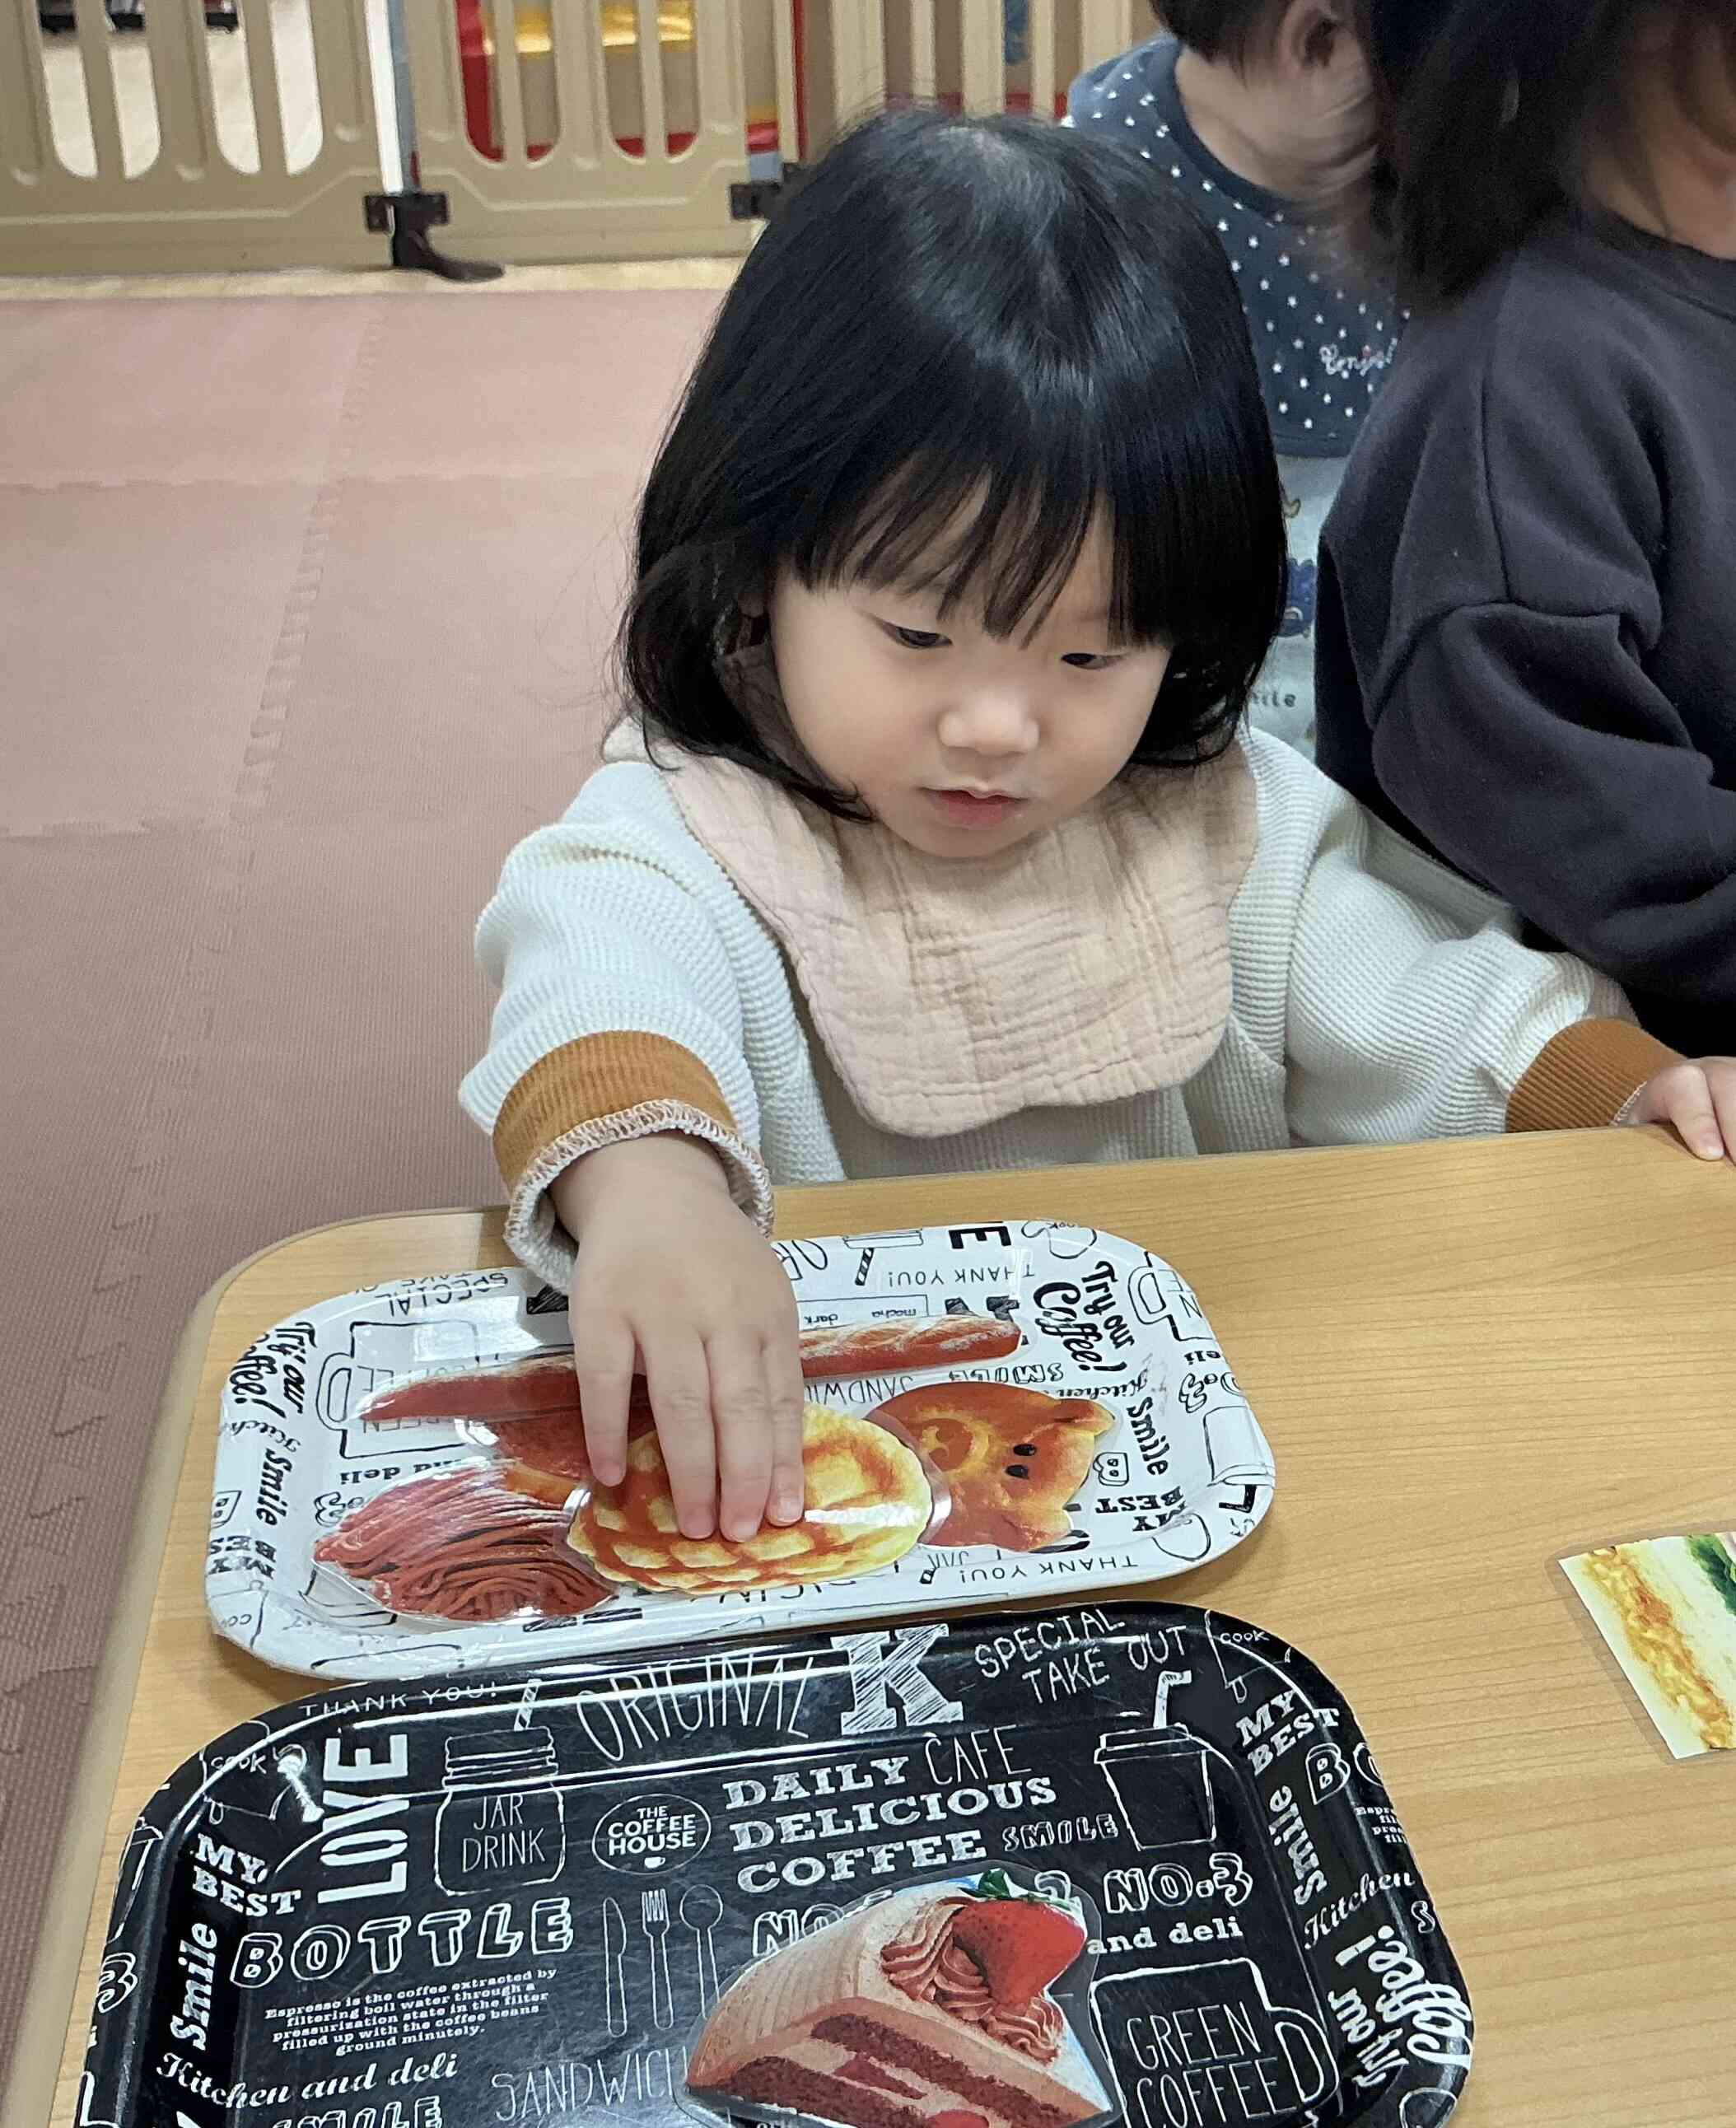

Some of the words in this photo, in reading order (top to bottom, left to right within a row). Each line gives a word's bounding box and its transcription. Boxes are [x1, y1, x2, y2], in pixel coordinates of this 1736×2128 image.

[889, 1270, 945, 1288] YOU!
[955, 1263, 1035, 1284] THANK
[1033, 1281, 1127, 1372] Coffee!
[1081, 1261, 1118, 1315] Try
[1104, 1314, 1135, 1350] our
[1127, 1396, 1171, 1476] Smile
[258, 1448, 293, 1525] Smile
[340, 1466, 401, 1485] deli
[1095, 1486, 1185, 1514] BEST
[959, 1565, 1028, 1584] YOU!
[1039, 1555, 1139, 1575] THANK
[974, 1609, 1126, 1678] SPECIAL
[1022, 1648, 1110, 1703] TAKE
[1128, 1626, 1186, 1671] OUT
[299, 1693, 407, 1717] THANK
[422, 1681, 497, 1706] YOU!
[576, 1654, 814, 1761] ORIGINAL
[831, 1623, 964, 1735] K
[1236, 1690, 1297, 1747] MY
[924, 1724, 1032, 1785] CAFE
[1248, 1708, 1341, 1776] BEST
[722, 1756, 909, 1809] DAILY
[318, 1734, 409, 1904] LOVE
[474, 1793, 525, 1830] JAR
[608, 1813, 696, 1839] COFFEE
[637, 1805, 668, 1819] THE
[730, 1776, 1057, 1852] DELICIOUS
[1001, 1813, 1119, 1853] SMILE
[194, 1834, 267, 1883] MY
[462, 1827, 546, 1874] DRINK
[609, 1831, 696, 1856] HOUSE
[738, 1830, 987, 1892] COFFEE
[1268, 1785, 1328, 1905] Smile
[191, 1866, 301, 1916] BEST
[1103, 1852, 1253, 1914] NO.3
[1304, 1872, 1415, 1950] Kitchen
[230, 1897, 574, 1989] BOTTLE
[1086, 1927, 1157, 1955] and
[1169, 1916, 1244, 1944] deli
[170, 1923, 217, 2051] Smile
[265, 2001, 342, 2018] Espresso
[346, 1997, 361, 2007] is
[365, 1992, 393, 2004] the
[397, 1985, 447, 2000] coffee
[452, 1970, 533, 1990] extracted
[537, 1968, 558, 1980] by
[287, 2008, 360, 2028] filtering
[364, 2002, 396, 2015] boil
[400, 1995, 450, 2010] water
[455, 1984, 520, 2002] through
[526, 1982, 535, 1991] a
[1328, 1987, 1376, 2044] our
[1335, 1925, 1472, 2070] Coffee!
[273, 2014, 399, 2042] pressurization
[403, 2007, 446, 2021] state
[450, 2004, 468, 2014] in
[472, 1999, 500, 2010] the
[504, 1992, 549, 2006] filter
[282, 2036, 329, 2051] filled
[334, 2032, 354, 2043] up
[358, 2024, 399, 2039] with
[403, 2020, 431, 2032] the
[435, 2013, 486, 2028] coffee
[490, 2004, 540, 2019] beans
[335, 2036, 397, 2056] ground
[401, 2024, 485, 2045] minutely.
[1127, 2001, 1262, 2070] GREEN
[156, 2052, 291, 2109] Kitchen
[301, 2063, 377, 2100] and
[389, 2052, 458, 2086] deli
[1353, 2028, 1410, 2088] Try
[1136, 2057, 1298, 2128] COFFEE
